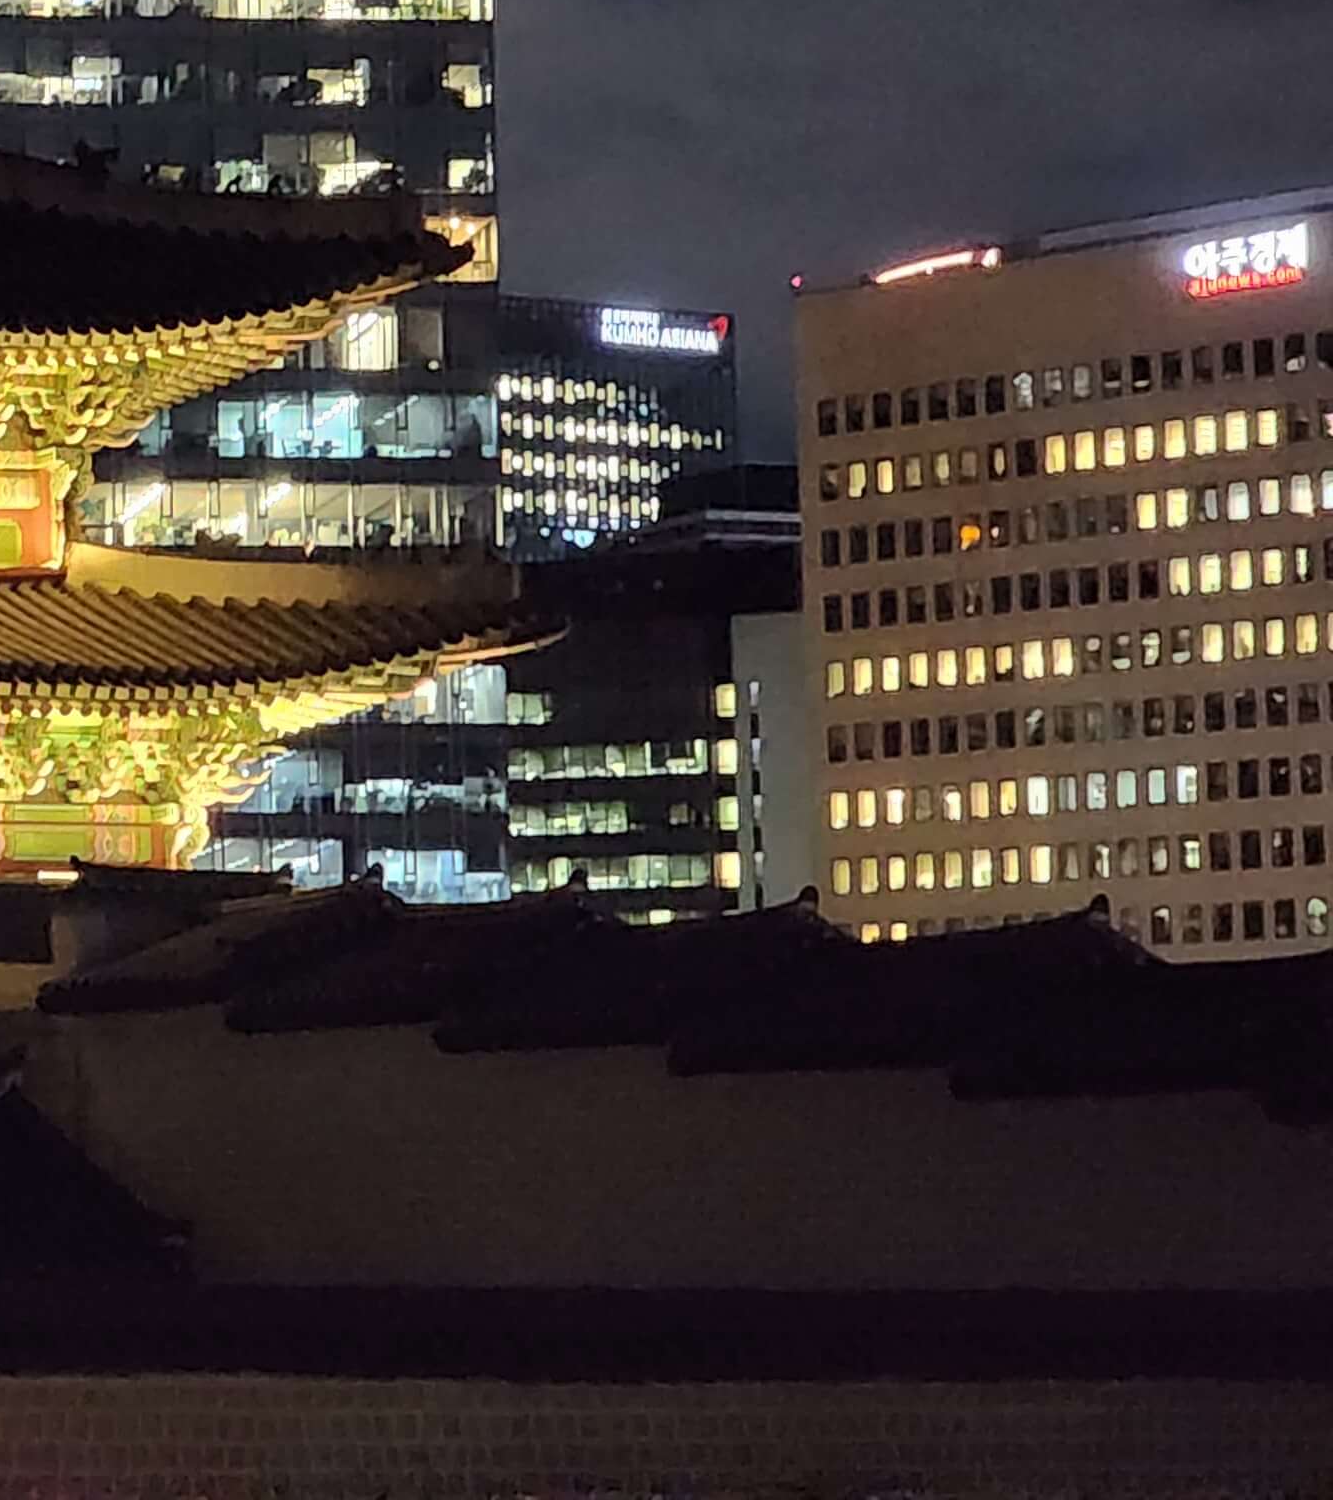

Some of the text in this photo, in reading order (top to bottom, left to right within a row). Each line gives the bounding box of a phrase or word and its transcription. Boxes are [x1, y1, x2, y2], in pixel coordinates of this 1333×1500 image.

[1183, 222, 1308, 280] 아주경제
[601, 322, 719, 353] KUMHO ASIANA
